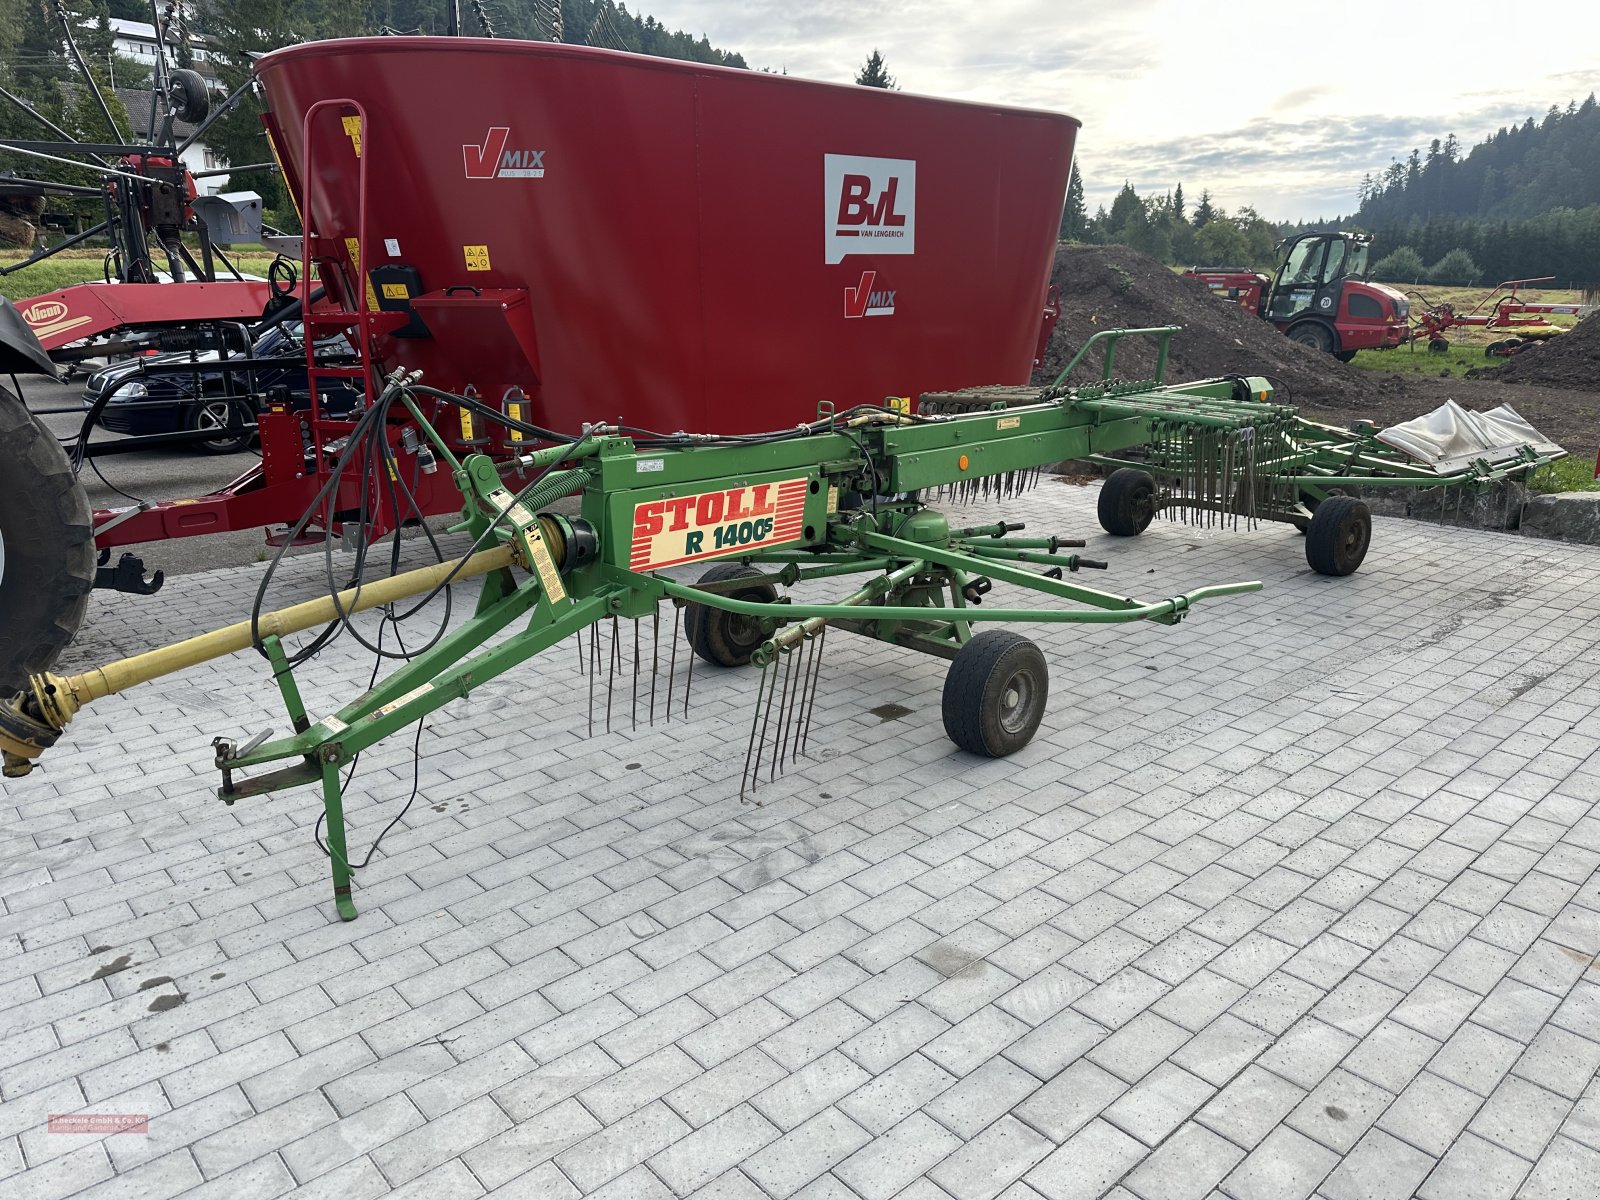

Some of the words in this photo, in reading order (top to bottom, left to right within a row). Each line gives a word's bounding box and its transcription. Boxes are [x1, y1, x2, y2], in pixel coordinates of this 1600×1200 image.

[861, 230, 873, 238] VAN
[874, 230, 904, 238] LENGERICH
[1322, 297, 1330, 306] 20
[24, 304, 61, 322] Vicon
[633, 485, 774, 538] STOLL
[685, 530, 704, 555] R
